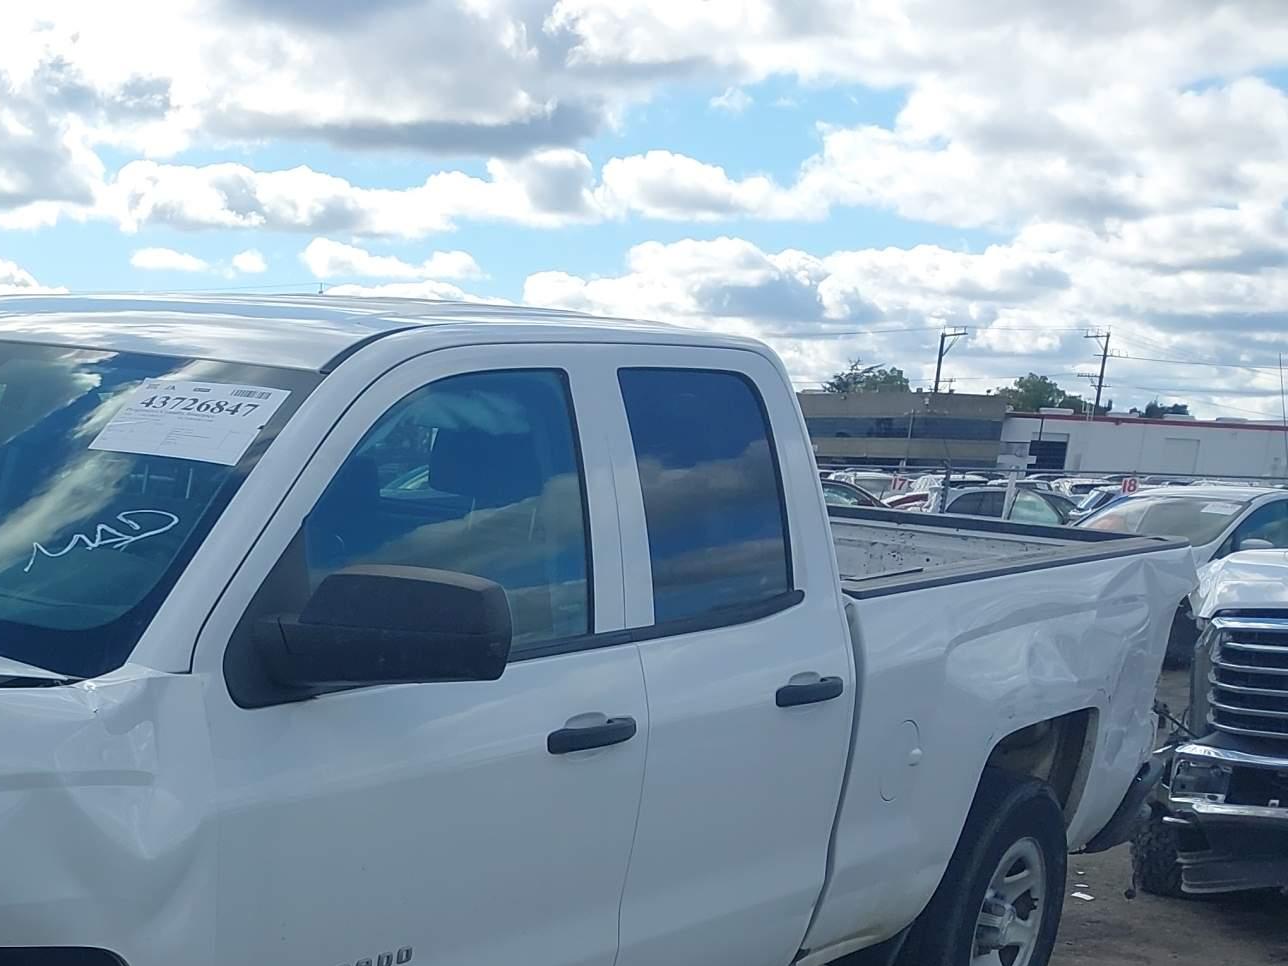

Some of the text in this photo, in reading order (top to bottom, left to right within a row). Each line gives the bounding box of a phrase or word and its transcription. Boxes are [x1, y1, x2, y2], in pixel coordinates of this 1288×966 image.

[140, 395, 260, 417] 43726847
[892, 477, 907, 491] 17
[1122, 478, 1138, 493] 18
